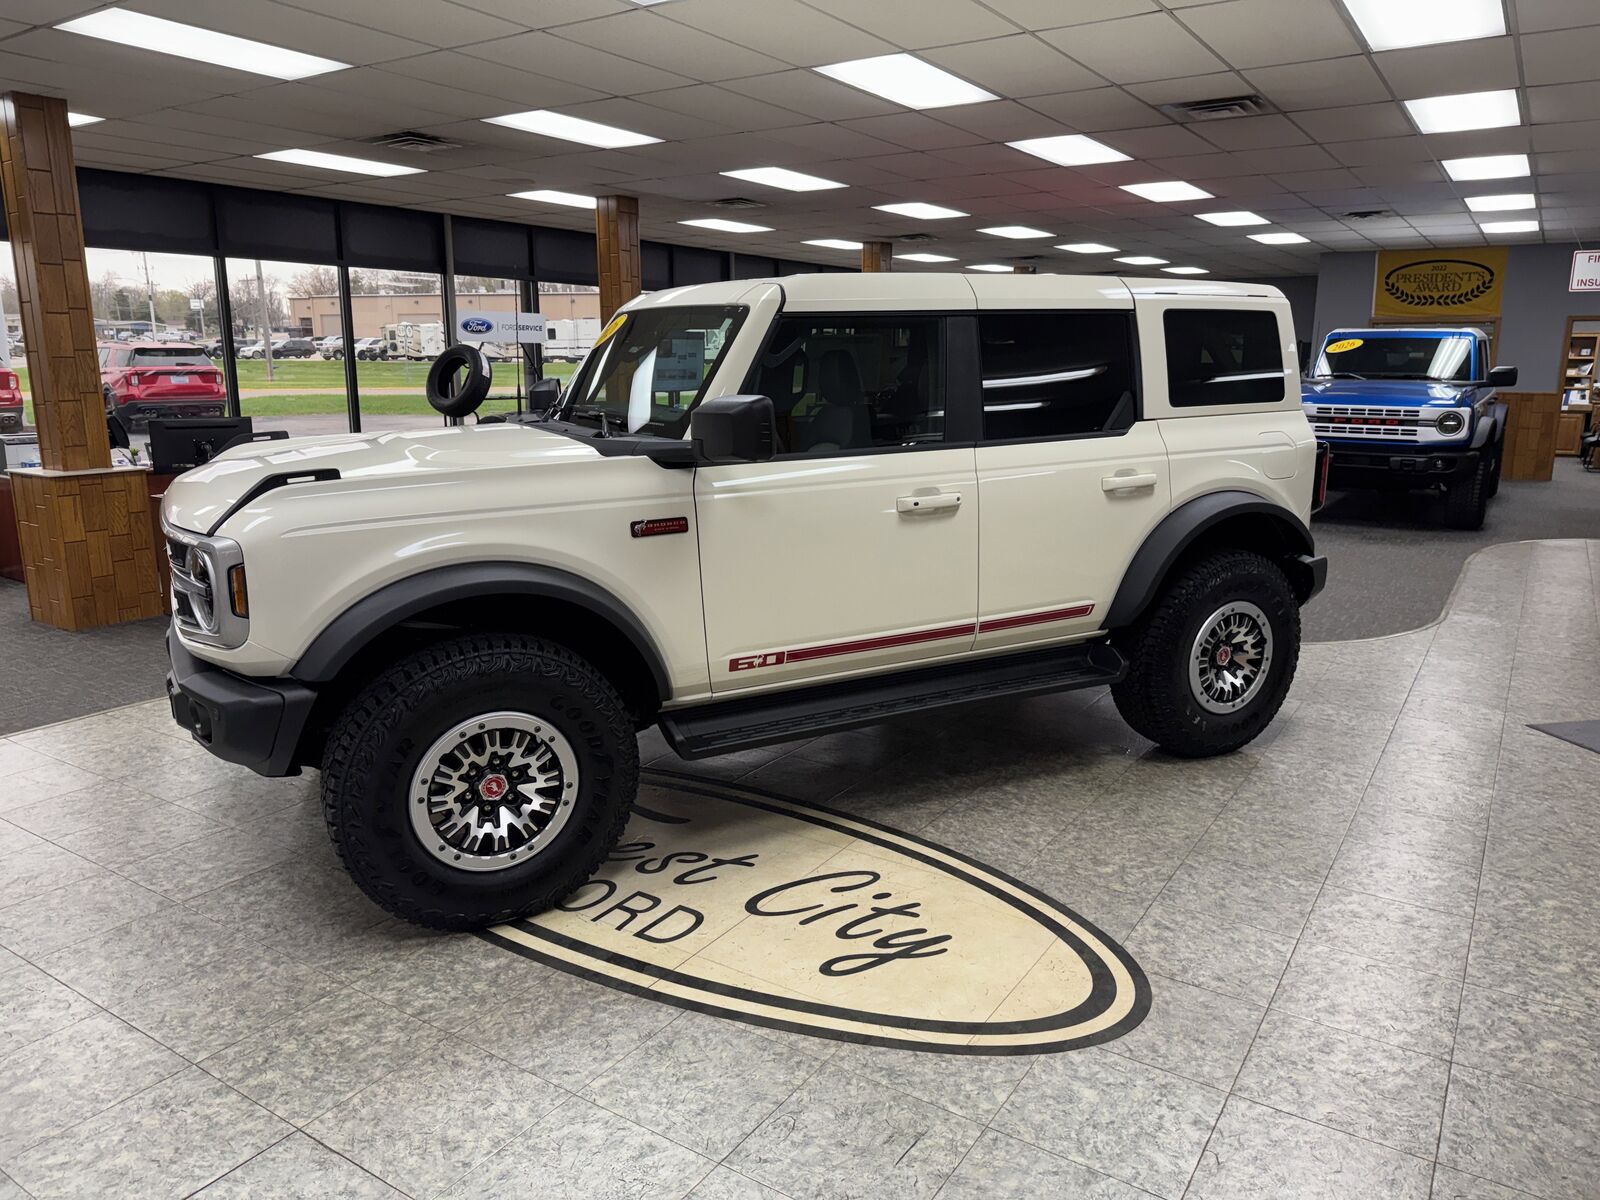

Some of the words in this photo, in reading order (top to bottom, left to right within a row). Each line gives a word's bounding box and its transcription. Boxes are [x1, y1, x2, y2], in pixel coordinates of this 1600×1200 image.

[1396, 271, 1486, 284] PRESIDENT'S
[1413, 281, 1462, 293] AWARD
[466, 319, 488, 332] Ford
[1334, 417, 1399, 425] FORD
[554, 879, 705, 944] ORD
[744, 870, 953, 977] City
